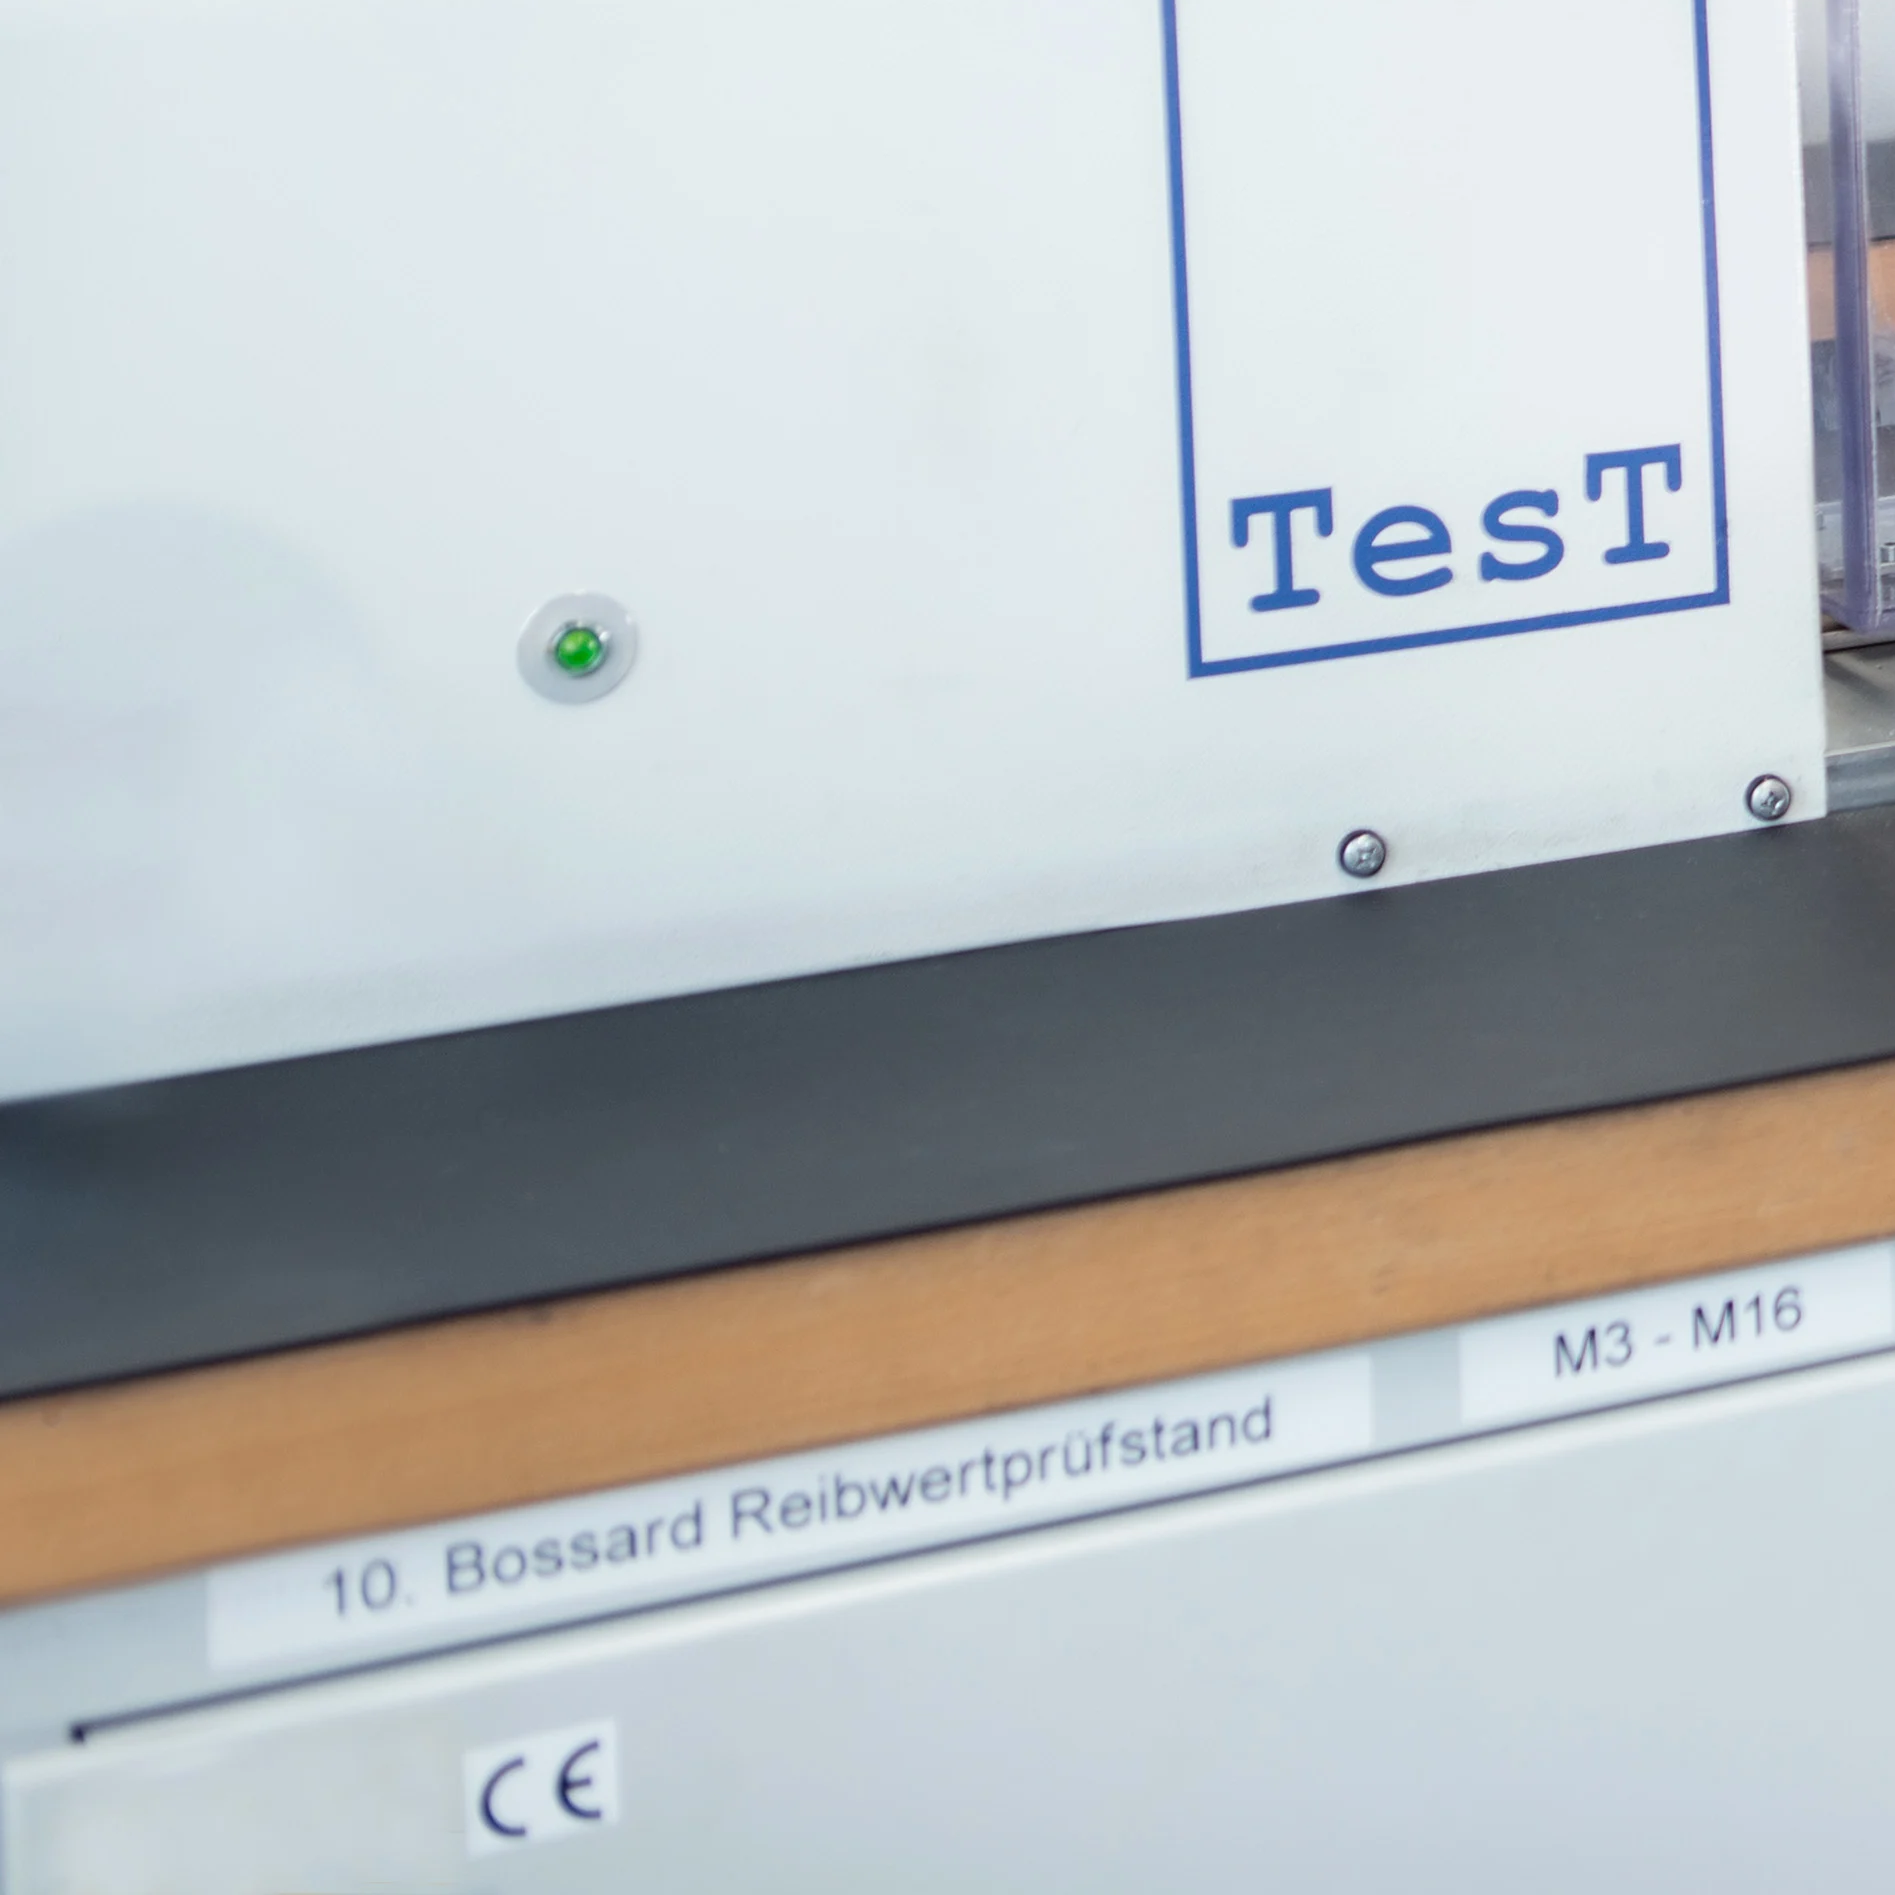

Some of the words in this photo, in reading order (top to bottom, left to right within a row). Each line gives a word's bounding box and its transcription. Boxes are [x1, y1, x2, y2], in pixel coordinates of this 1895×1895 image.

[1229, 442, 1685, 614] TesT
[1552, 1317, 1638, 1380] M3
[1690, 1284, 1806, 1353] M16
[323, 1560, 415, 1620] 10.
[445, 1496, 706, 1598] Bossard
[731, 1394, 1275, 1542] Reibwertprüfstand
